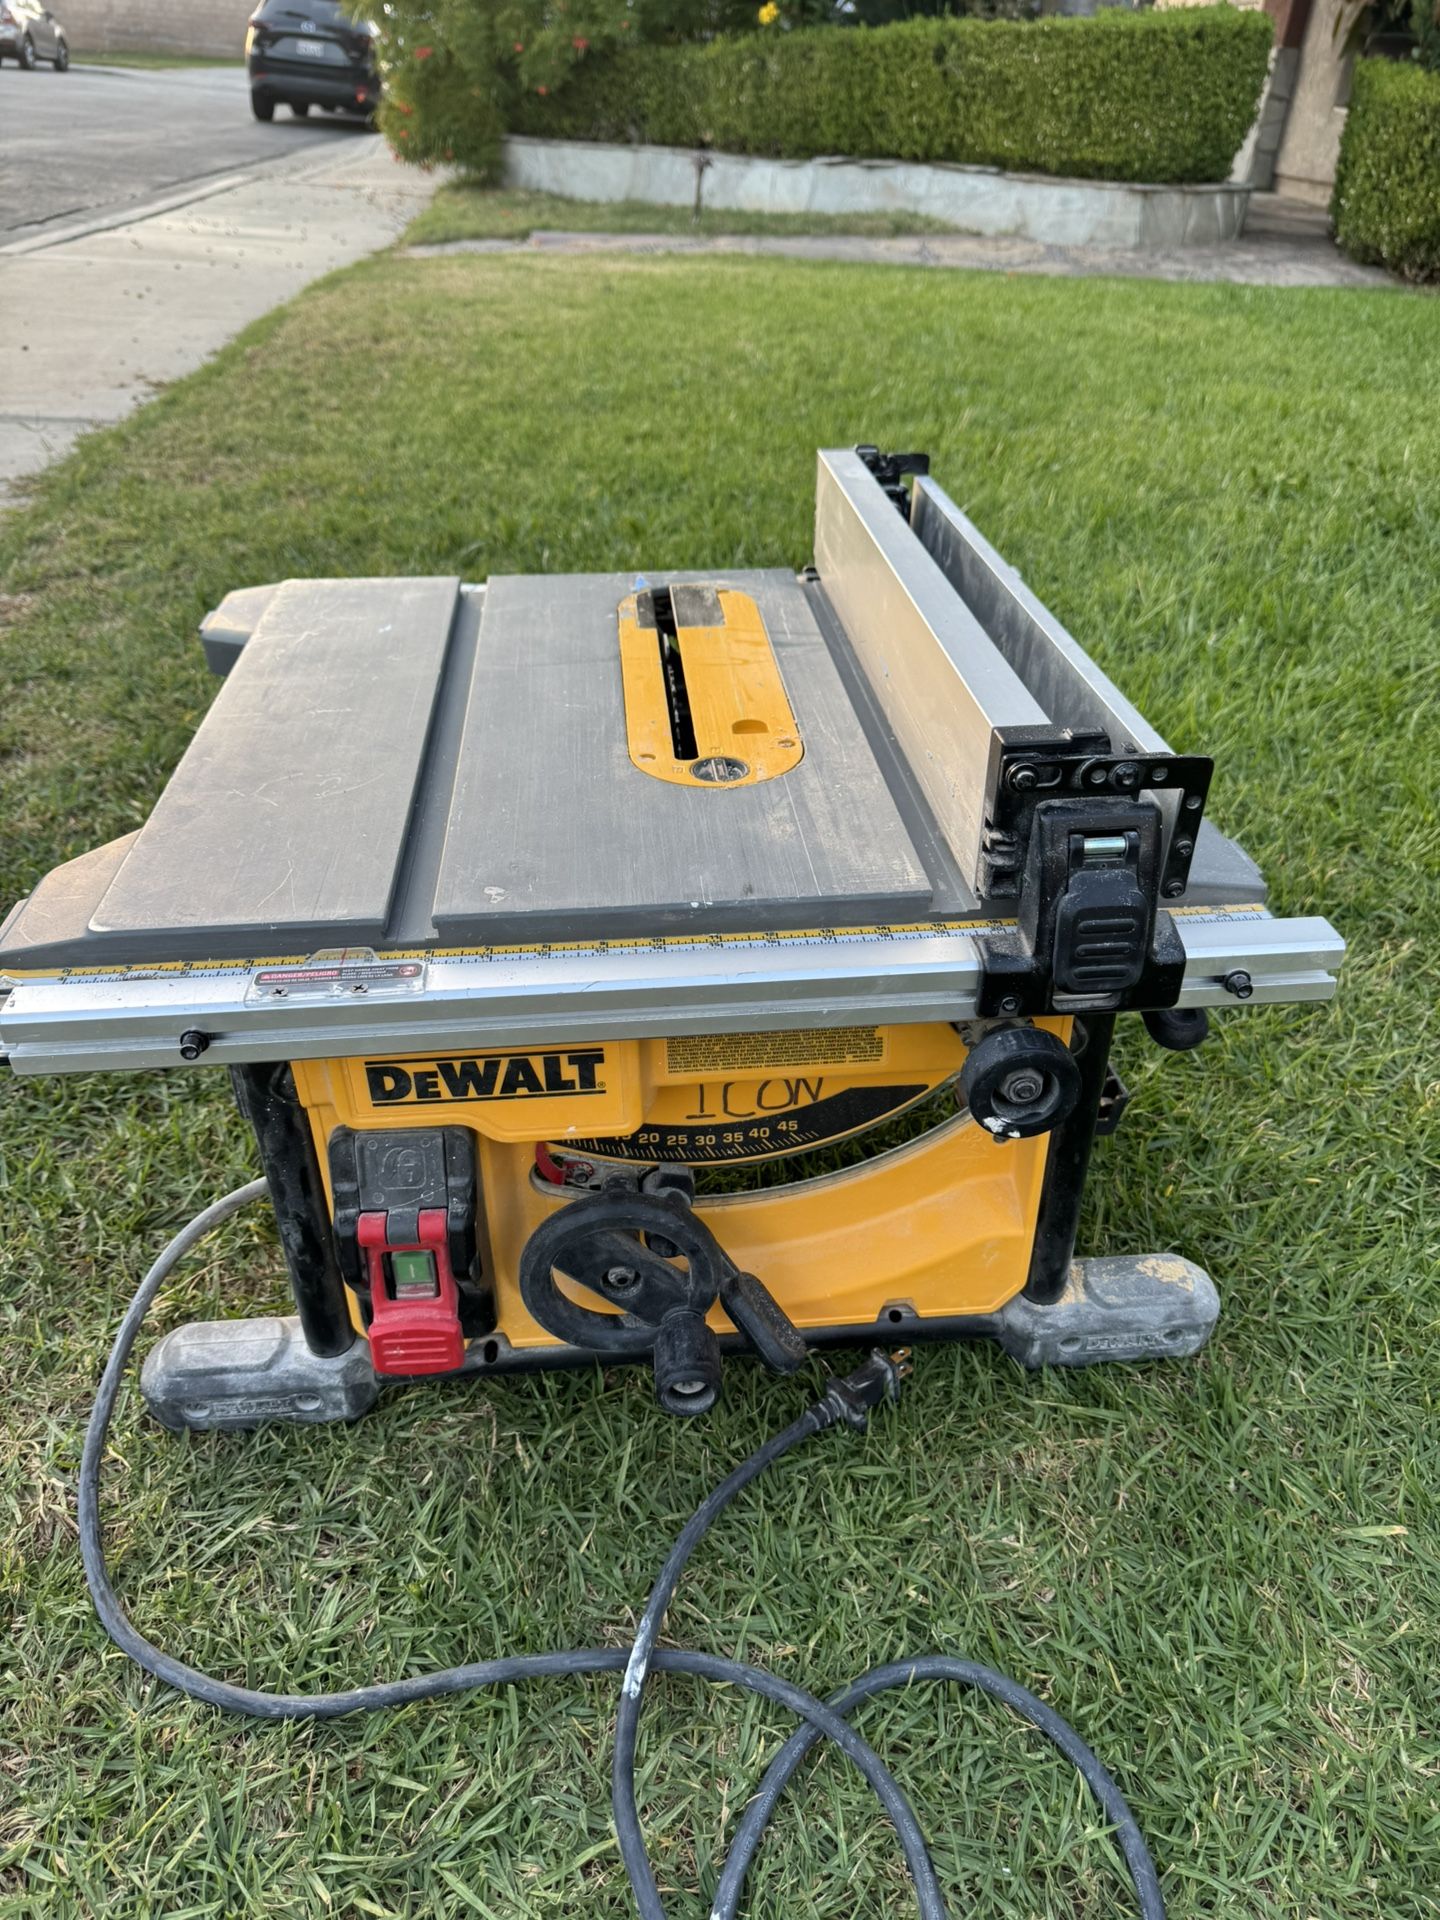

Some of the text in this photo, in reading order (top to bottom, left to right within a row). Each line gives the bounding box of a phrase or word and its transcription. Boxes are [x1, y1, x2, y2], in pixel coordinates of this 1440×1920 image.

[638, 1132, 660, 1144] 20
[667, 1134, 688, 1145] 25
[695, 1135, 716, 1146] 30
[723, 1132, 744, 1143] 35
[749, 1127, 770, 1138] 40
[776, 1120, 798, 1131] 45
